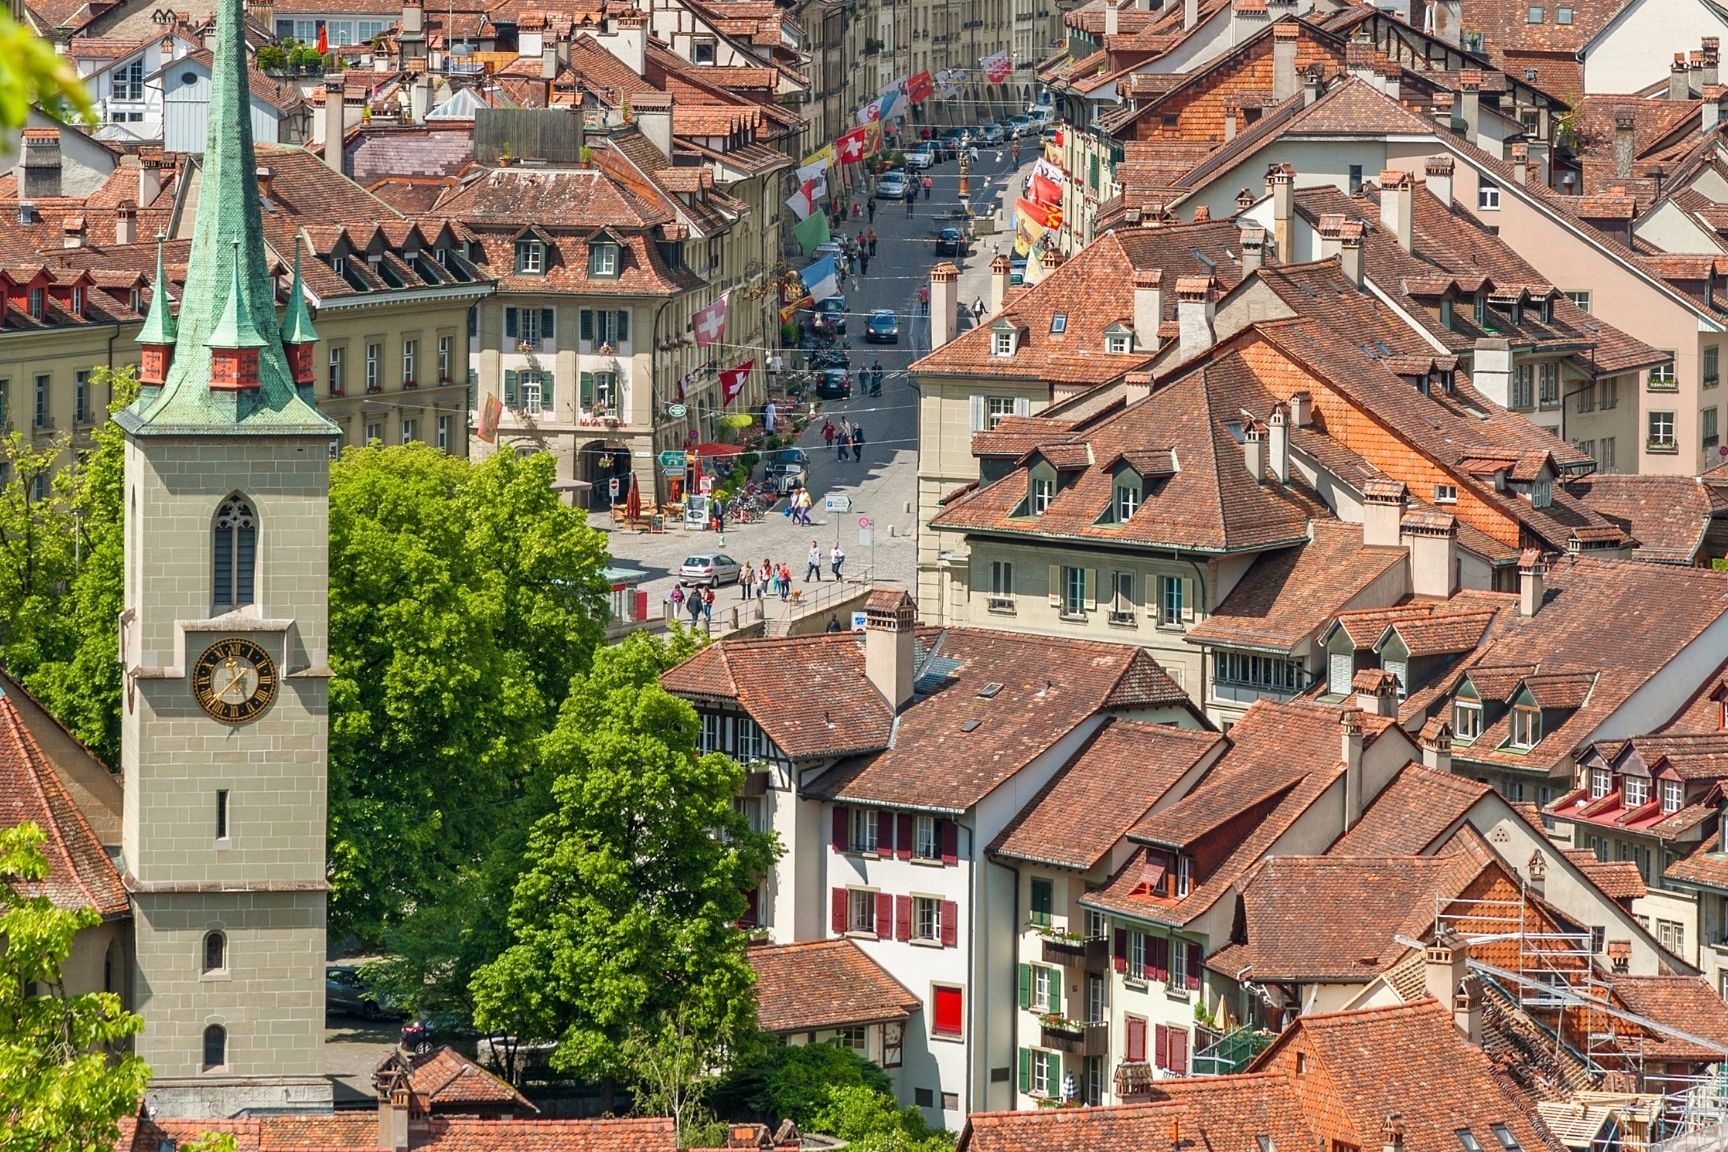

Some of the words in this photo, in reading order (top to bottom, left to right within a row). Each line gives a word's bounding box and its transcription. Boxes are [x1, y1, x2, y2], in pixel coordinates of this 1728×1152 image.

[229, 644, 241, 655] XII
[248, 648, 254, 658] I
[256, 660, 267, 669] II
[260, 676, 271, 684] III
